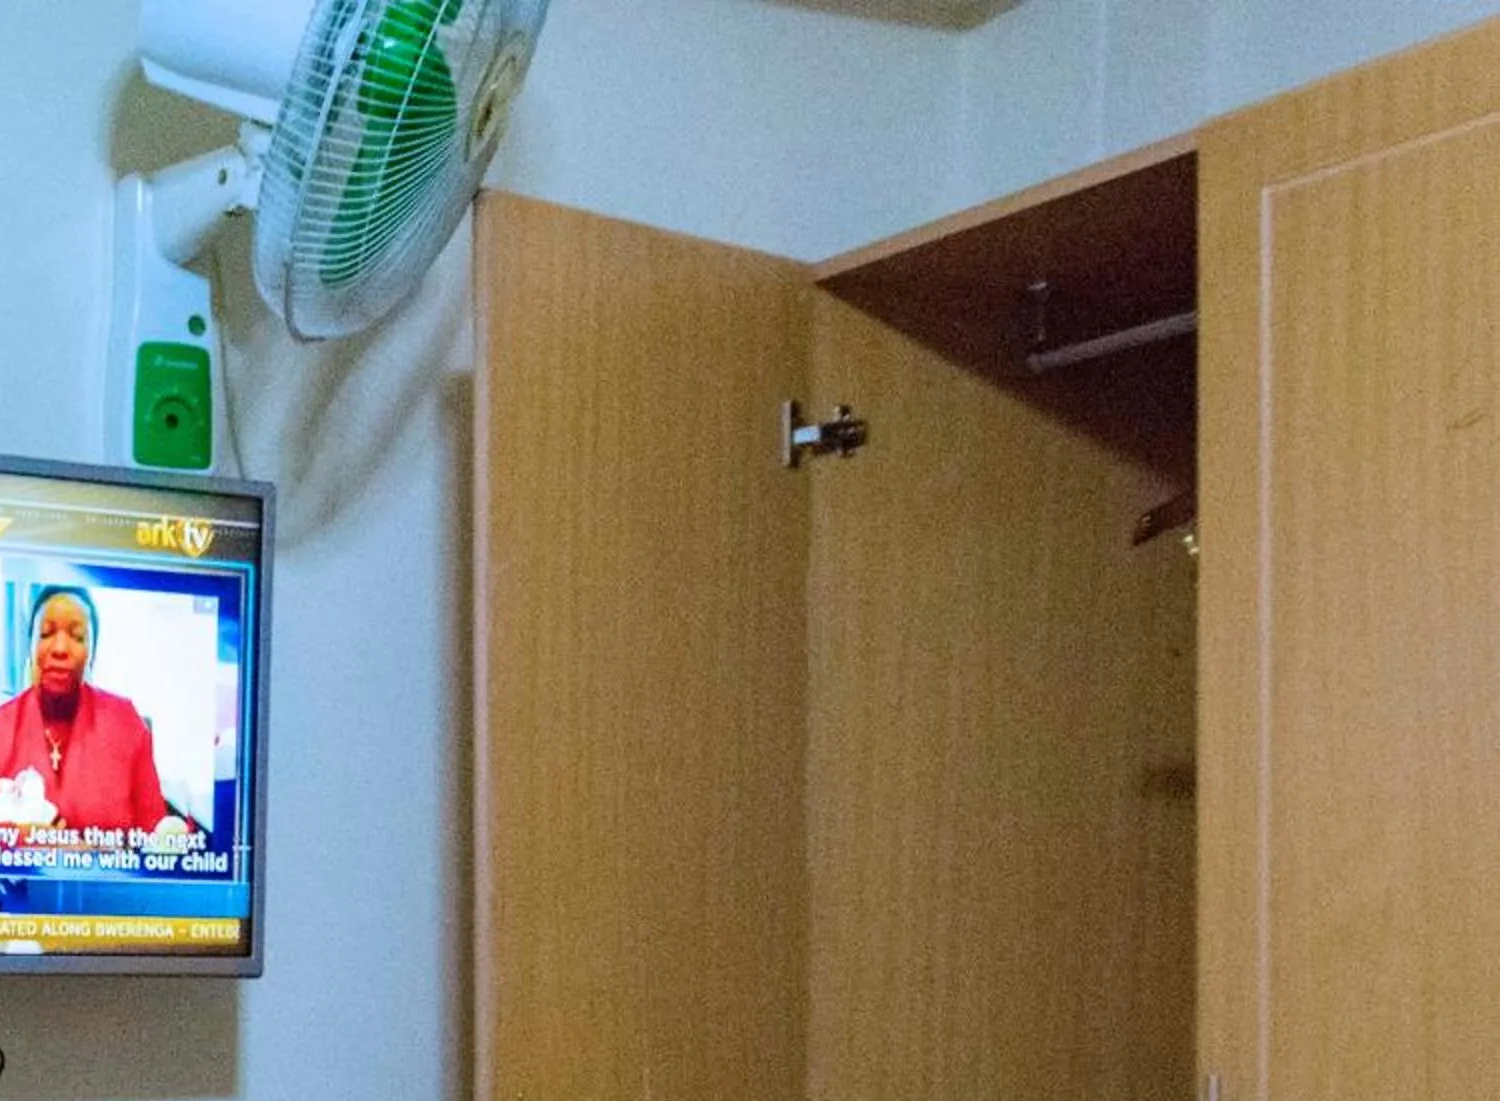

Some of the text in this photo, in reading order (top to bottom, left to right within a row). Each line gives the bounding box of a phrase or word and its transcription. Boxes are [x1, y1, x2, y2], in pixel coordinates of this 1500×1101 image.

[136, 514, 177, 549] ark
[25, 827, 79, 845] Jesus
[84, 826, 125, 846] that
[128, 827, 161, 847] the
[165, 830, 207, 850] next
[64, 852, 93, 869] me
[99, 850, 140, 871] with
[144, 855, 176, 872] our
[181, 851, 228, 873] child
[41, 921, 91, 938] ALONG
